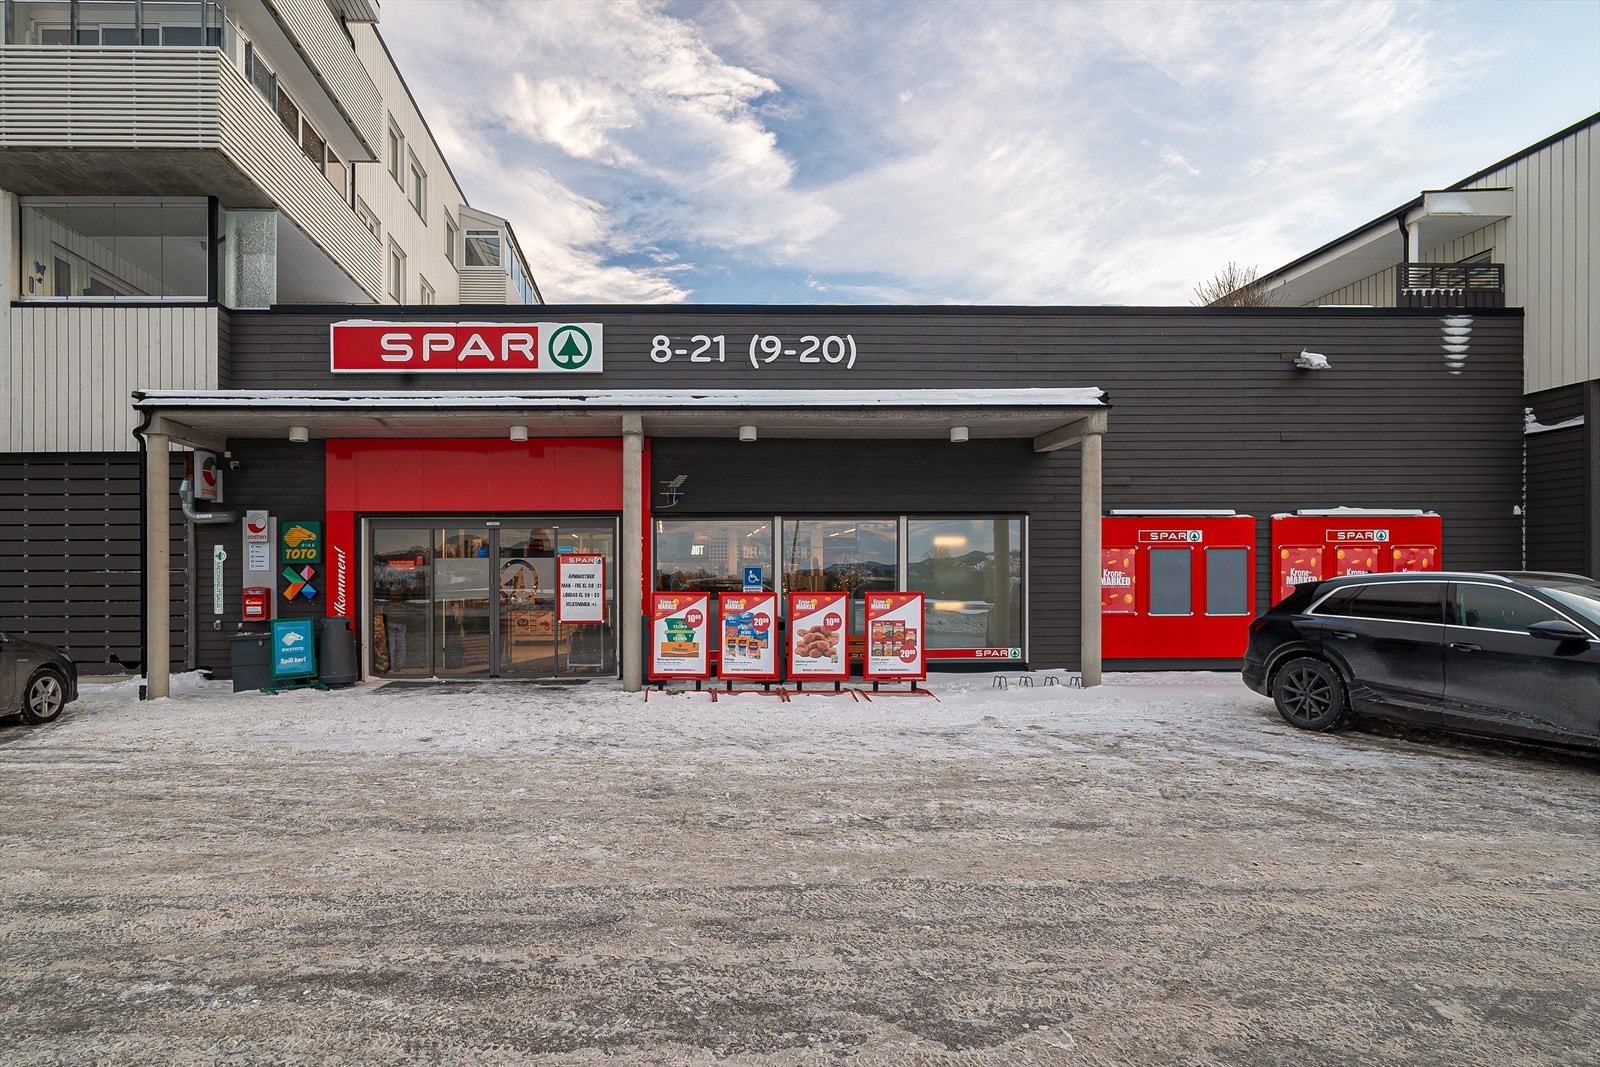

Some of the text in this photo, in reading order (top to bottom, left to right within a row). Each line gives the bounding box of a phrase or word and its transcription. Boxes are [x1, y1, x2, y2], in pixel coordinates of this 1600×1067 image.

[380, 333, 534, 362] SPAR
[650, 334, 856, 369] 8-21 (9-20)
[286, 549, 317, 559] TOTO
[1103, 568, 1125, 577] Krone-
[1290, 568, 1312, 576] Krone-
